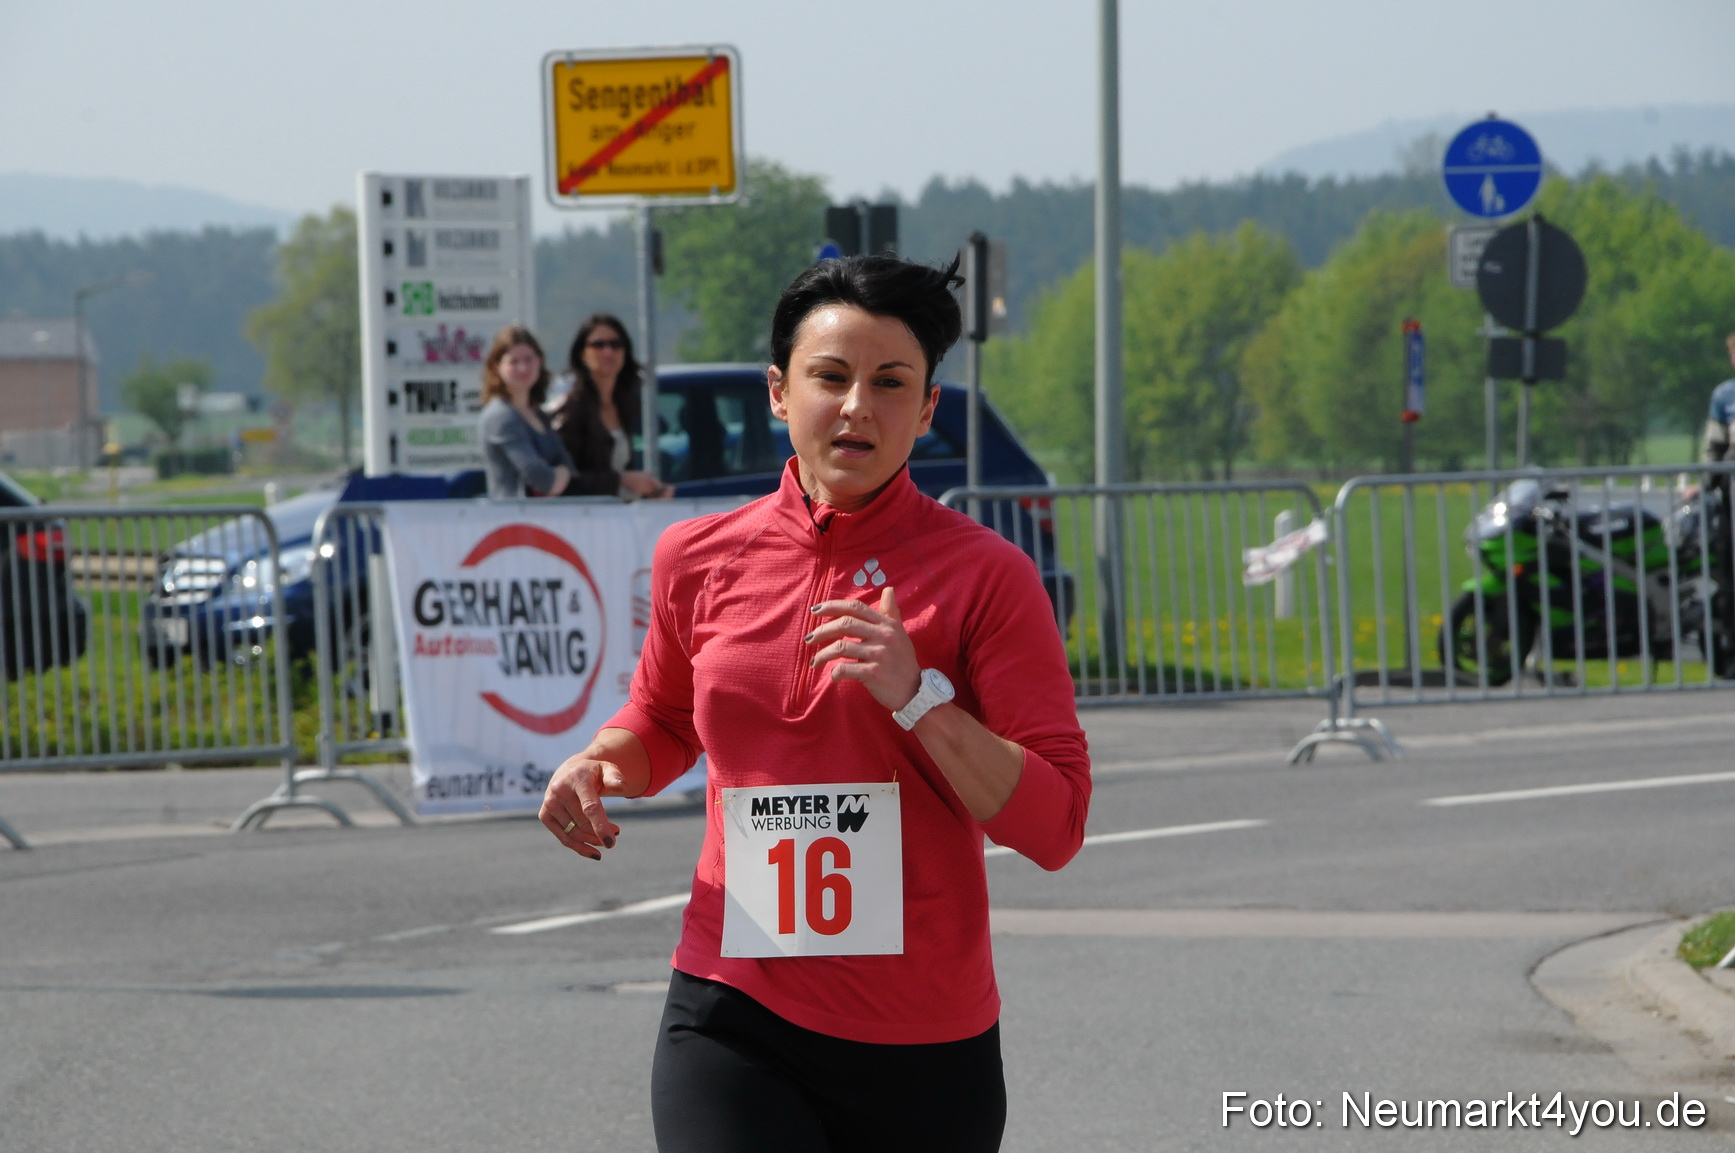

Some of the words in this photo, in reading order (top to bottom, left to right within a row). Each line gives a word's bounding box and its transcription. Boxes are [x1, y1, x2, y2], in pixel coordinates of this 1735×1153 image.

[568, 74, 716, 118] Sengenthal
[413, 578, 564, 627] GERHART
[499, 629, 587, 677] JANIG
[426, 764, 505, 799] eumarkt
[751, 795, 831, 816] MEYER
[751, 816, 831, 831] WERBUNG
[767, 836, 853, 936] 16
